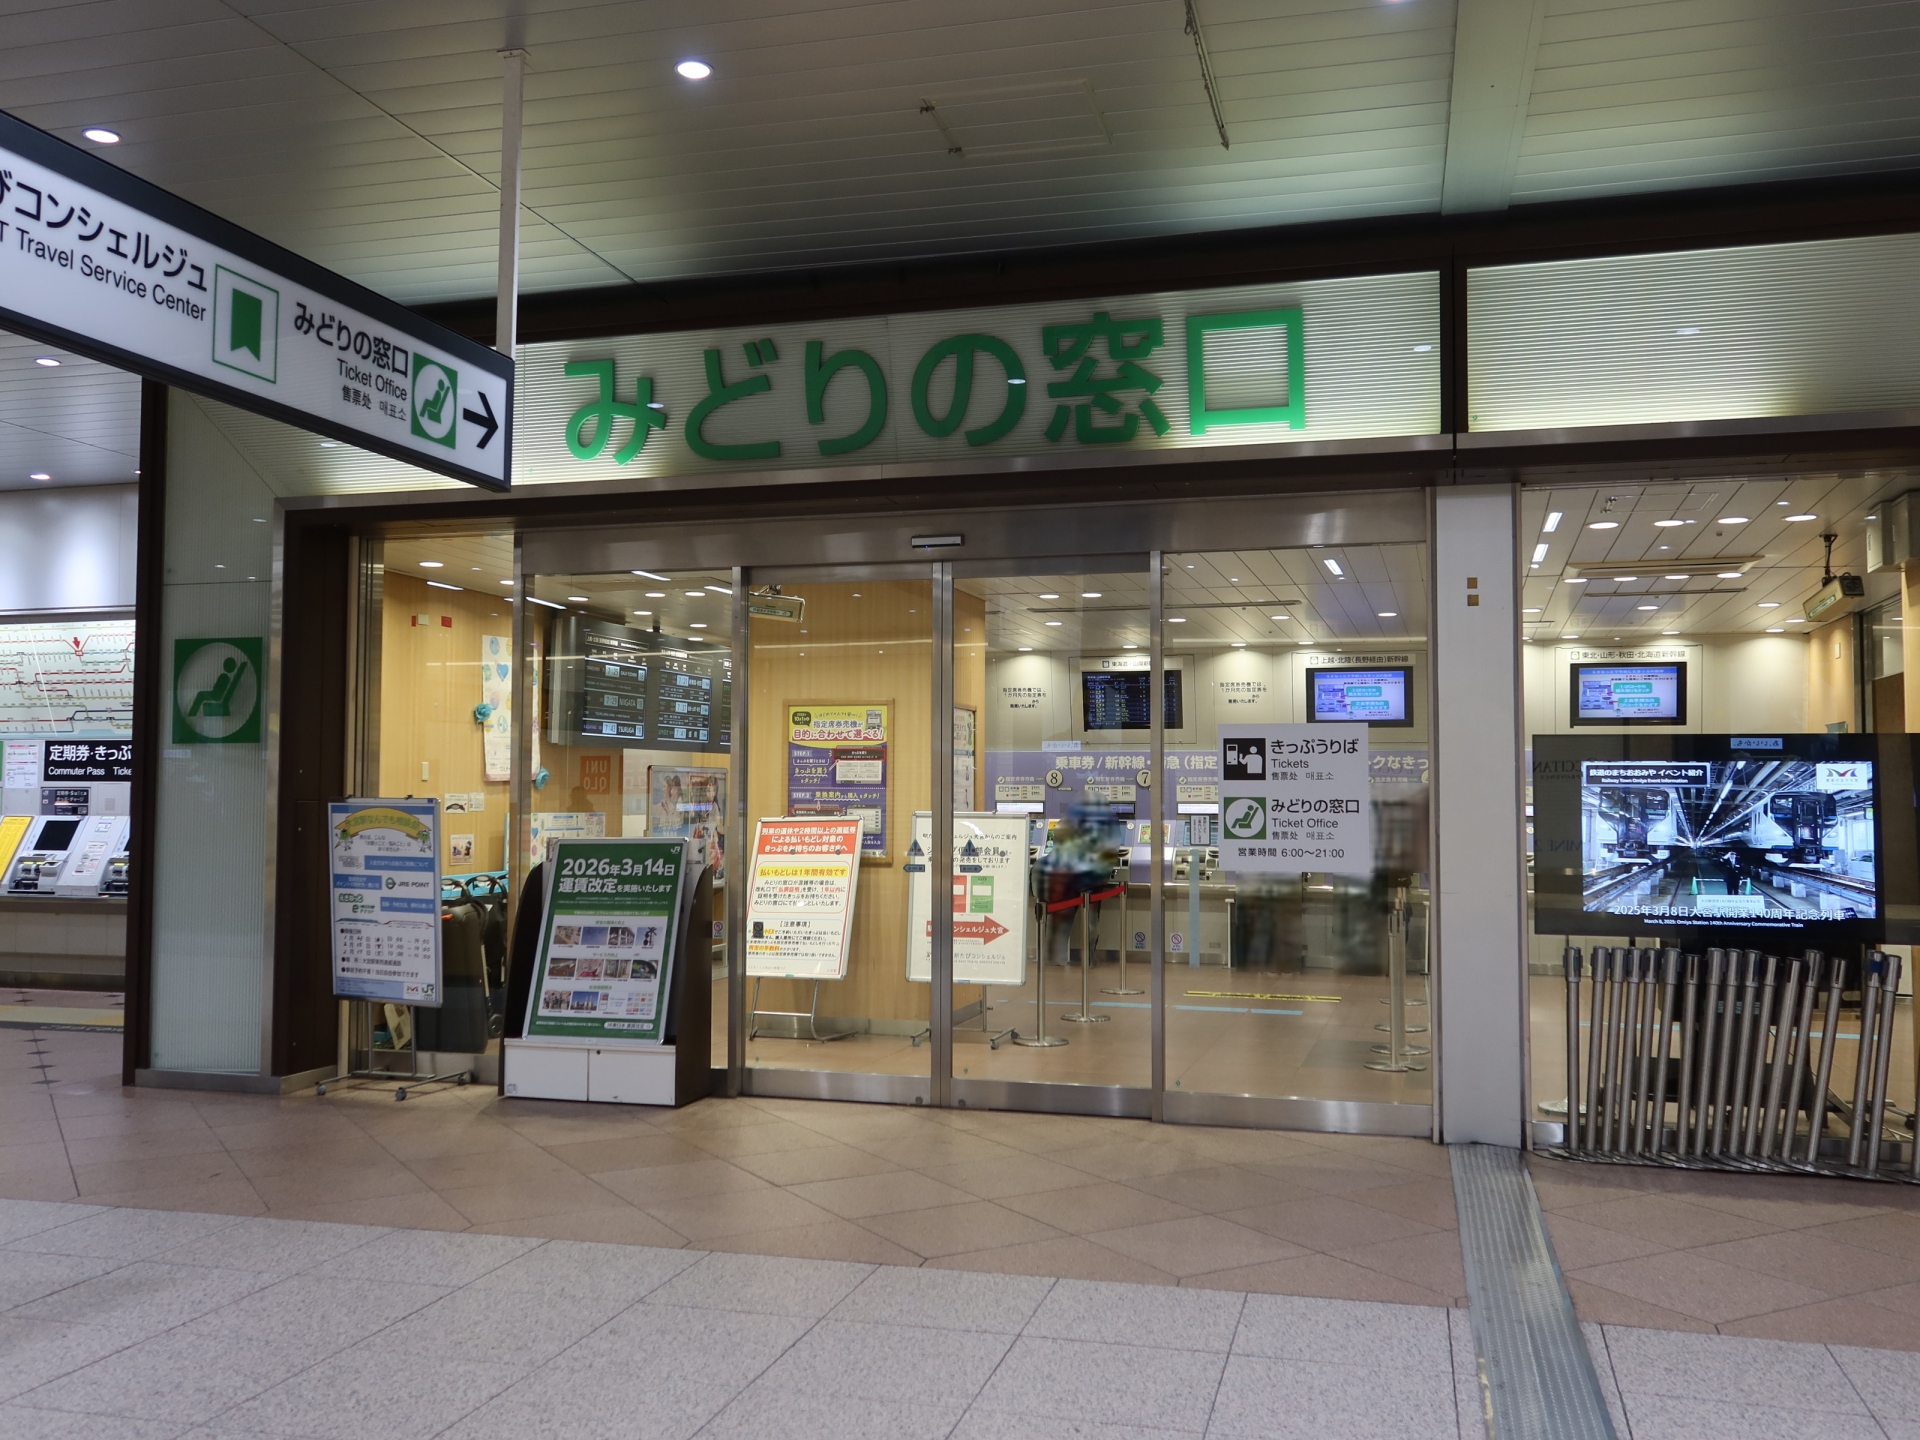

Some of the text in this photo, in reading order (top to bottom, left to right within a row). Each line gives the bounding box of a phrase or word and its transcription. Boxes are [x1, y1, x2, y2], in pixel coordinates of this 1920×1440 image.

[16, 227, 74, 270] Travel
[80, 254, 147, 299] Service
[152, 284, 207, 322] Center
[294, 301, 409, 378] みどりの窓口
[337, 359, 408, 402] Ticket Office
[563, 307, 1305, 466] みどりの窓口
[341, 385, 407, 423] 售票处 매표소
[1581, 651, 1686, 660] 東北・山形・秋田・北海道新幹線
[813, 720, 863, 729] 指定席券売機が
[1270, 738, 1360, 755] きっぷうりば
[49, 744, 132, 762] 定期券・きっぷ
[1271, 759, 1309, 769] Tickets
[48, 766, 86, 776] Commuter
[86, 767, 105, 776] Pass
[1271, 771, 1334, 781] 售票处 매표소
[1589, 768, 1704, 777] 鉄道のまちおおみや イベント紹介
[1050, 772, 1058, 784] 8
[1141, 772, 1148, 784] 7
[1271, 798, 1360, 814] みどりの窓口
[1271, 818, 1339, 829] Ticket Office
[771, 835, 844, 843] による払いもどし対象の
[1271, 831, 1335, 841] 售票处 매표소
[1238, 847, 1277, 857] 営業時間
[561, 858, 676, 876] 2026年3月14日
[760, 868, 847, 877] 払いもどしは1年間有効です
[557, 877, 673, 893] 運賃改定を実施いたします
[1613, 904, 1847, 921] 2025年3月8日大宮駅開業140周年記念列車
